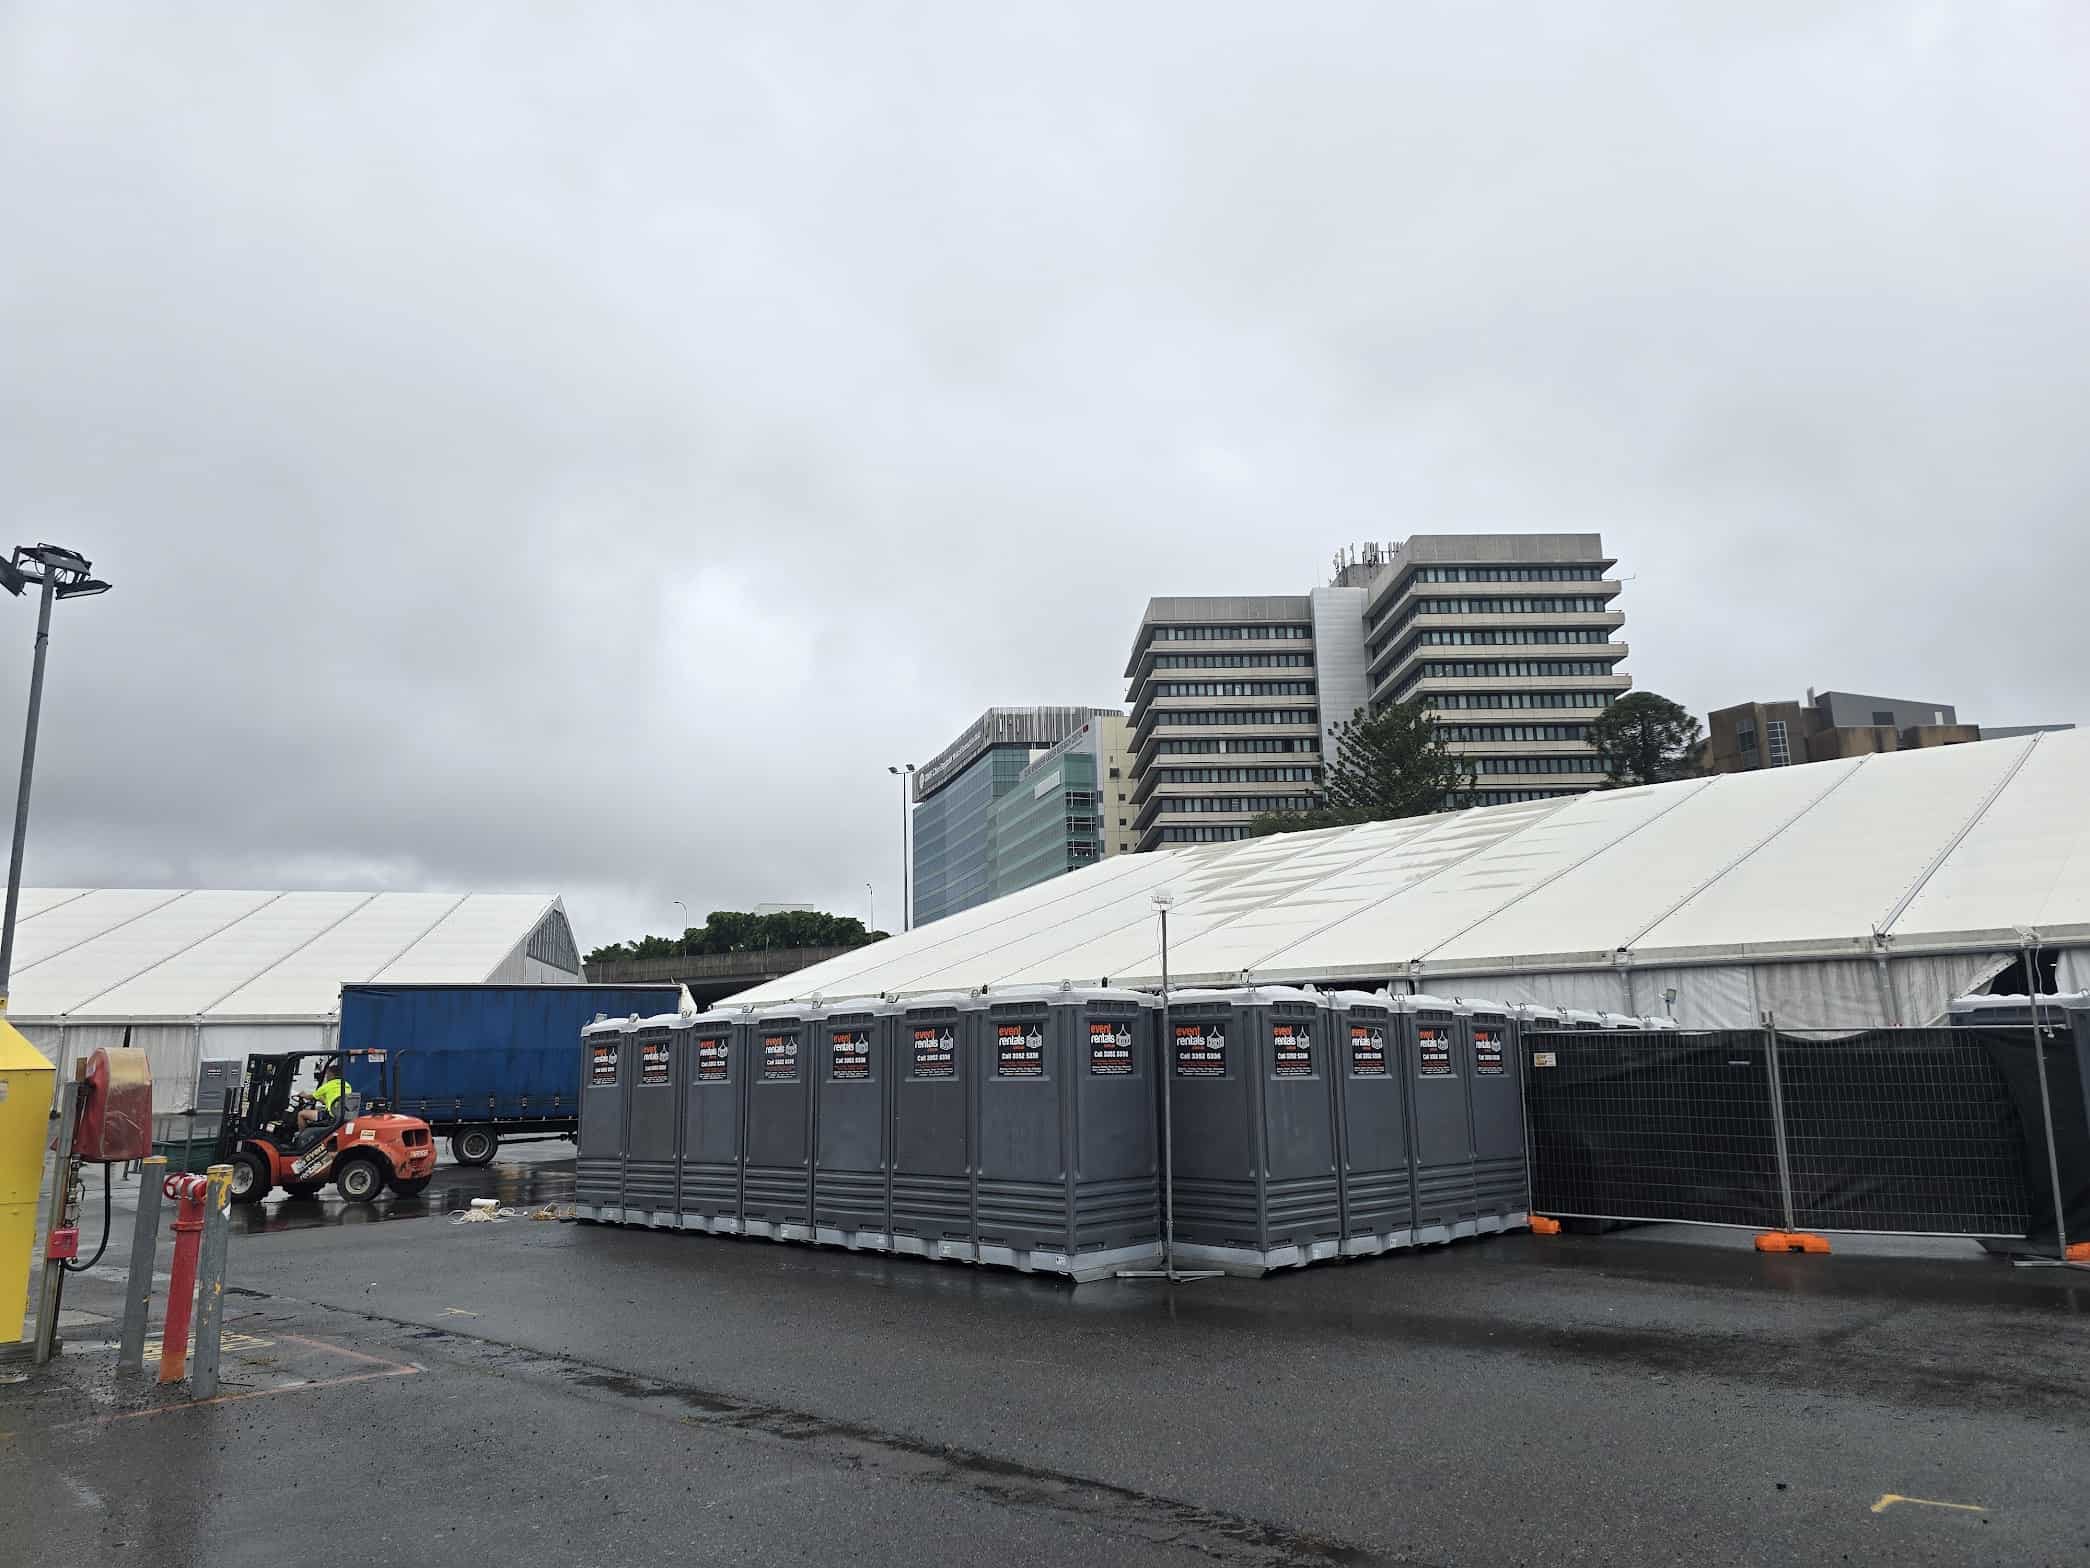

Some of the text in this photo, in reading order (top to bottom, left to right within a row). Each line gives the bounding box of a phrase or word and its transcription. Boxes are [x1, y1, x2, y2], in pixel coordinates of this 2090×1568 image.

[998, 1025, 1021, 1036] event
[1090, 1023, 1111, 1034] event
[1175, 1026, 1200, 1036] event
[999, 1035, 1025, 1046] rentals
[1090, 1032, 1116, 1044] rentals
[1176, 1035, 1206, 1046] rentals
